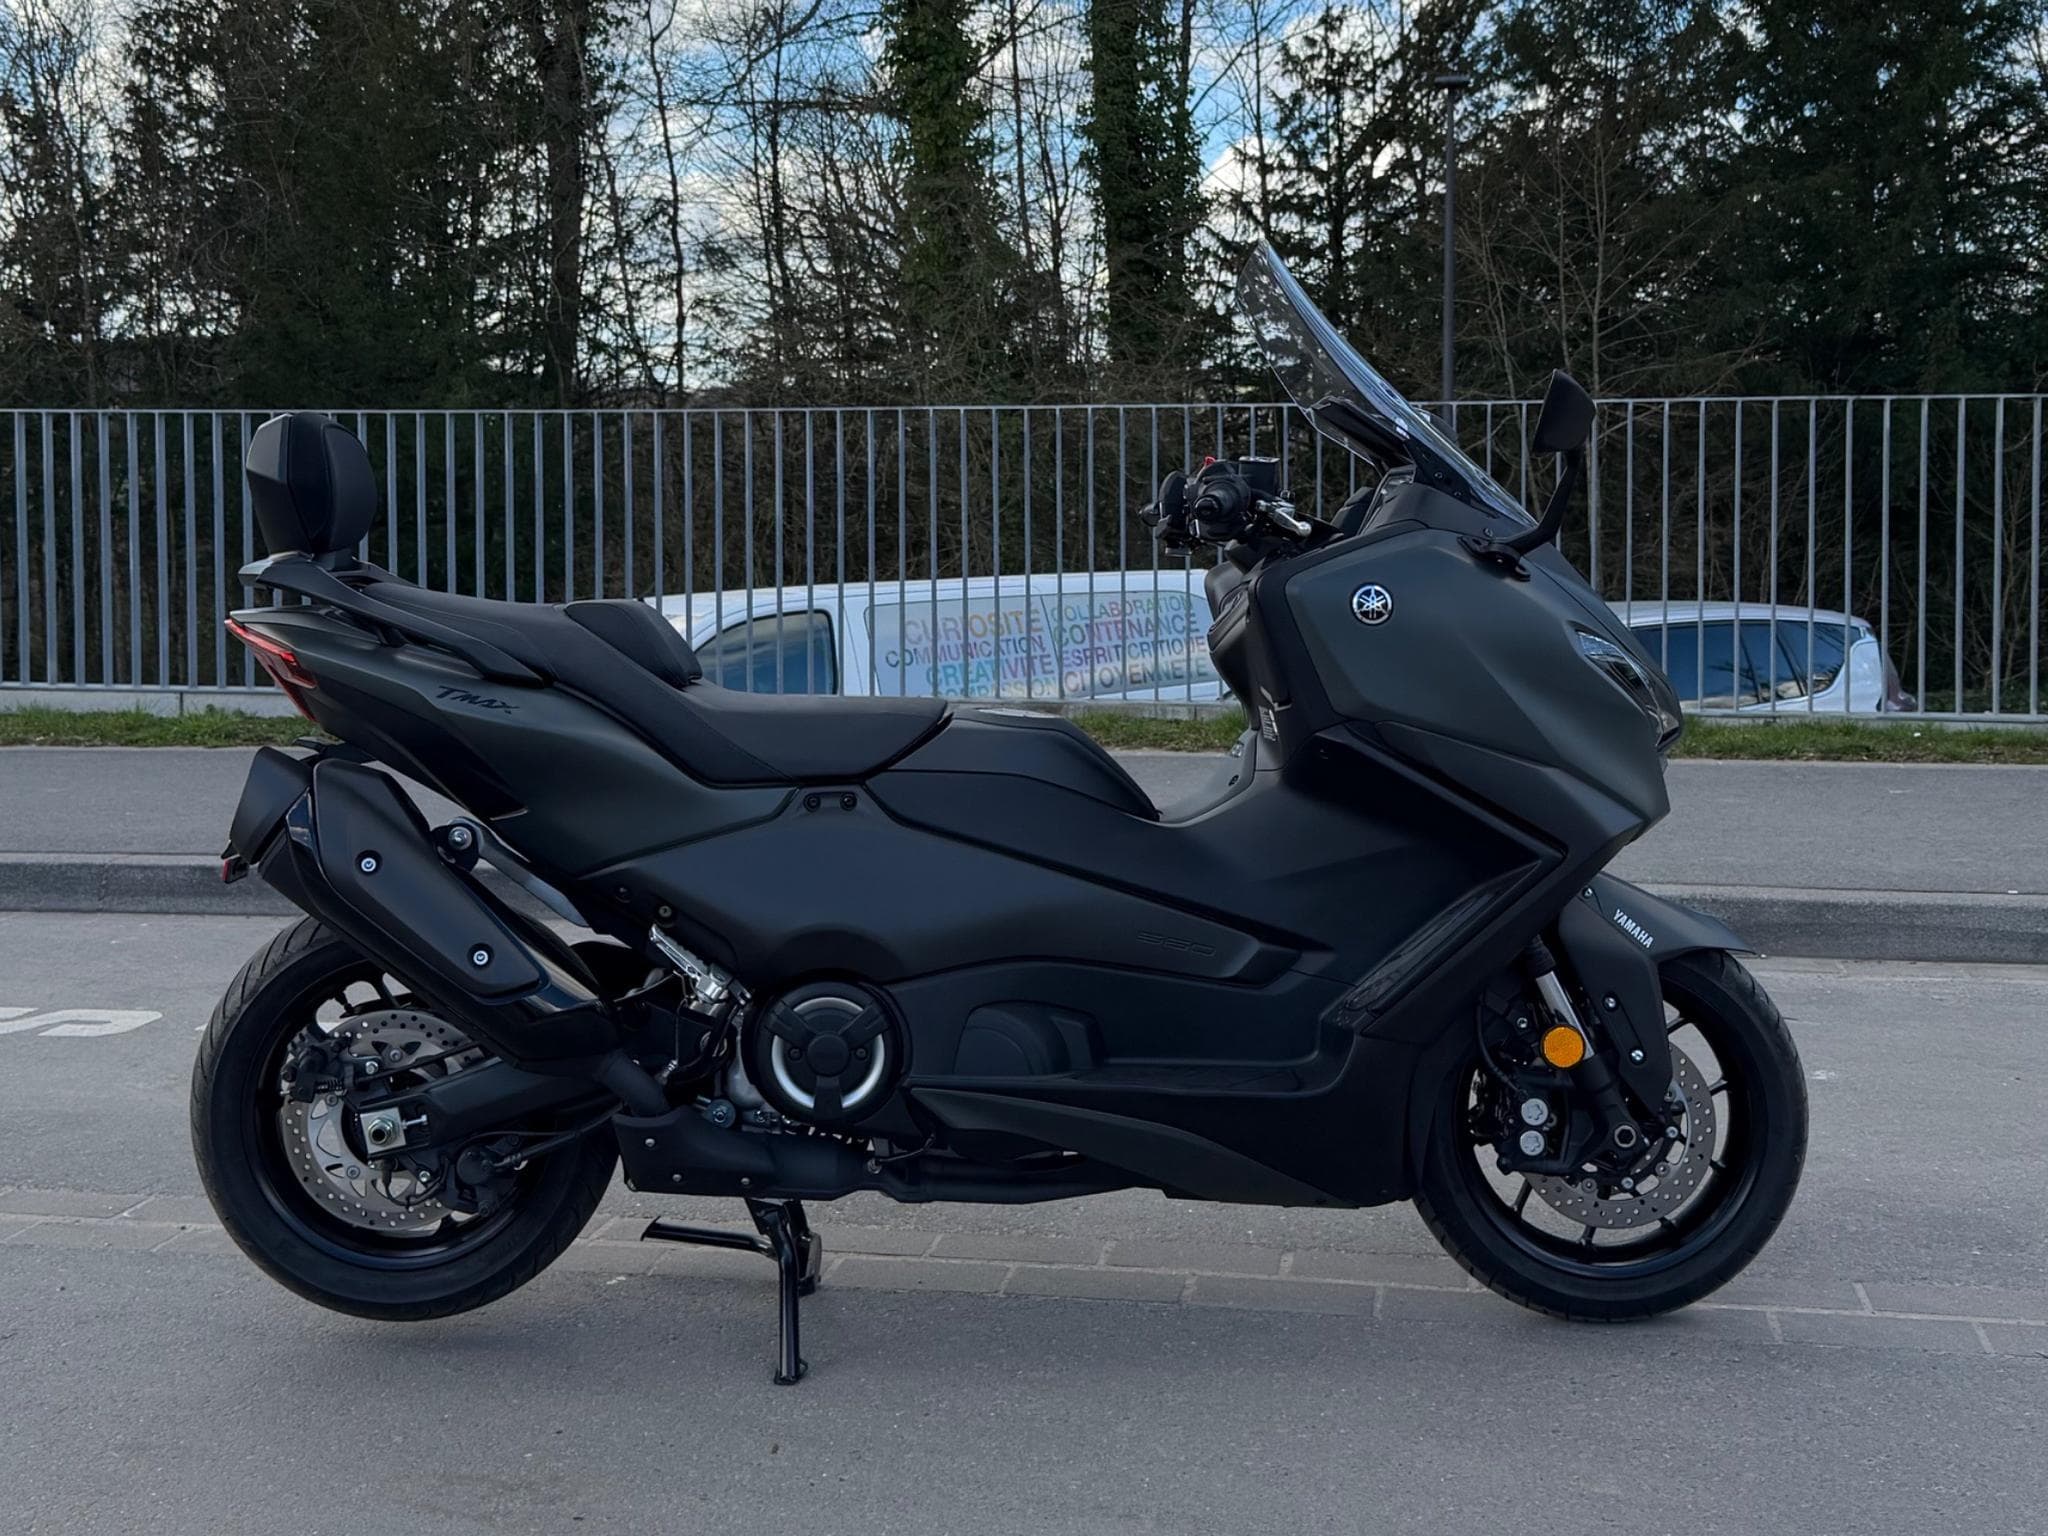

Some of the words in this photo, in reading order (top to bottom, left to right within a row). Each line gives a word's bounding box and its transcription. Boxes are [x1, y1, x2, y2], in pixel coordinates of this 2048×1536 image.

[905, 608, 1044, 645] CUROSITE
[1127, 636, 1206, 660] CRTIQUE
[1064, 656, 1209, 693] CIOYENNEE
[436, 684, 520, 714] TMAX
[1613, 908, 1654, 949] YAMAHA
